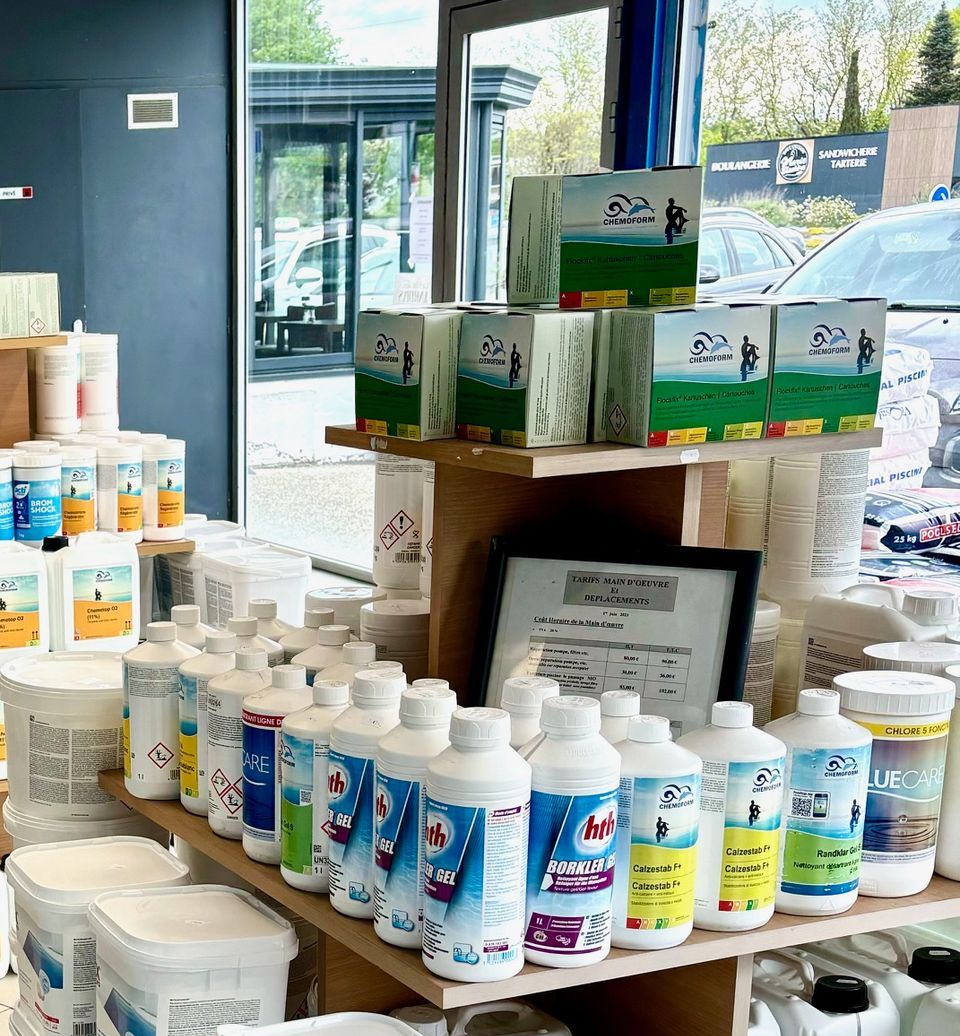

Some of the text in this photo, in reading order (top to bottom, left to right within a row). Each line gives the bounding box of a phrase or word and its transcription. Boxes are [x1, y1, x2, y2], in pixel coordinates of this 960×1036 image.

[818, 146, 878, 160] SANDWICHERIE
[711, 159, 771, 172] BOULANGERIE
[831, 159, 867, 169] TARTERIE
[603, 216, 656, 226] CHEMOFORM
[808, 346, 851, 356] CHEMOFORM
[689, 353, 733, 364] CHEMOFORM
[31, 505, 56, 513] SHOCK
[893, 534, 917, 543] 25 kg
[572, 575, 670, 588] TARIFS MAIN D'OEUVRE
[584, 594, 650, 605] DEPLACEMENTS
[534, 615, 547, 623] Coût
[257, 717, 275, 725] LIGNE
[885, 726, 922, 735] CHLORE
[922, 726, 928, 734] 5
[824, 769, 859, 778] CHEMOFORM
[752, 783, 782, 794] CHEMOFORM
[659, 801, 694, 810] CHEMOFORM
[336, 812, 352, 829] GEL
[583, 809, 615, 841] hth
[380, 837, 394, 855] GEL
[726, 845, 771, 857] Calzestab F+
[817, 848, 848, 858] Randklar
[546, 857, 605, 875] BORKLER
[633, 862, 682, 874] Calzestab F+
[725, 861, 770, 873] Calzestab F+
[793, 861, 825, 870] Nettoyant
[436, 868, 456, 886] GEL
[632, 880, 681, 891] Calzestab F+
